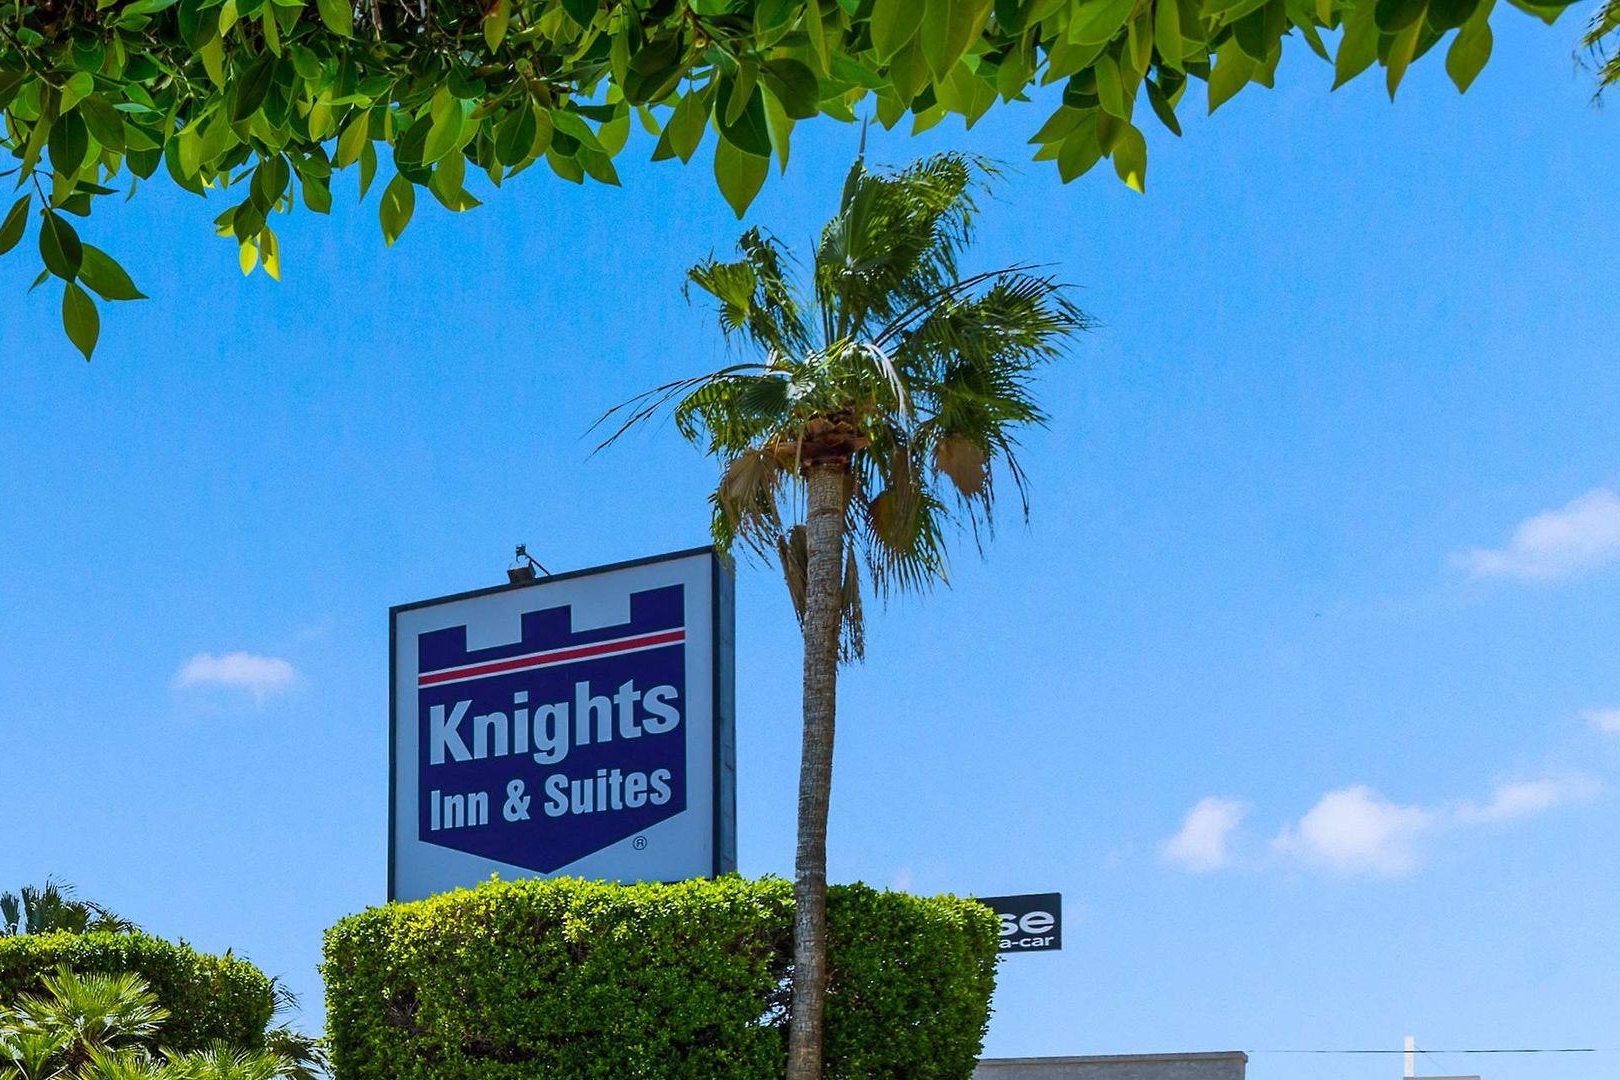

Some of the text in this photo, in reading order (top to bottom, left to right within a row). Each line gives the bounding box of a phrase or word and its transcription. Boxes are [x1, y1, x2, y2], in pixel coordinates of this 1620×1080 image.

[430, 679, 680, 765] Knights
[431, 768, 671, 831] Inn & Suites
